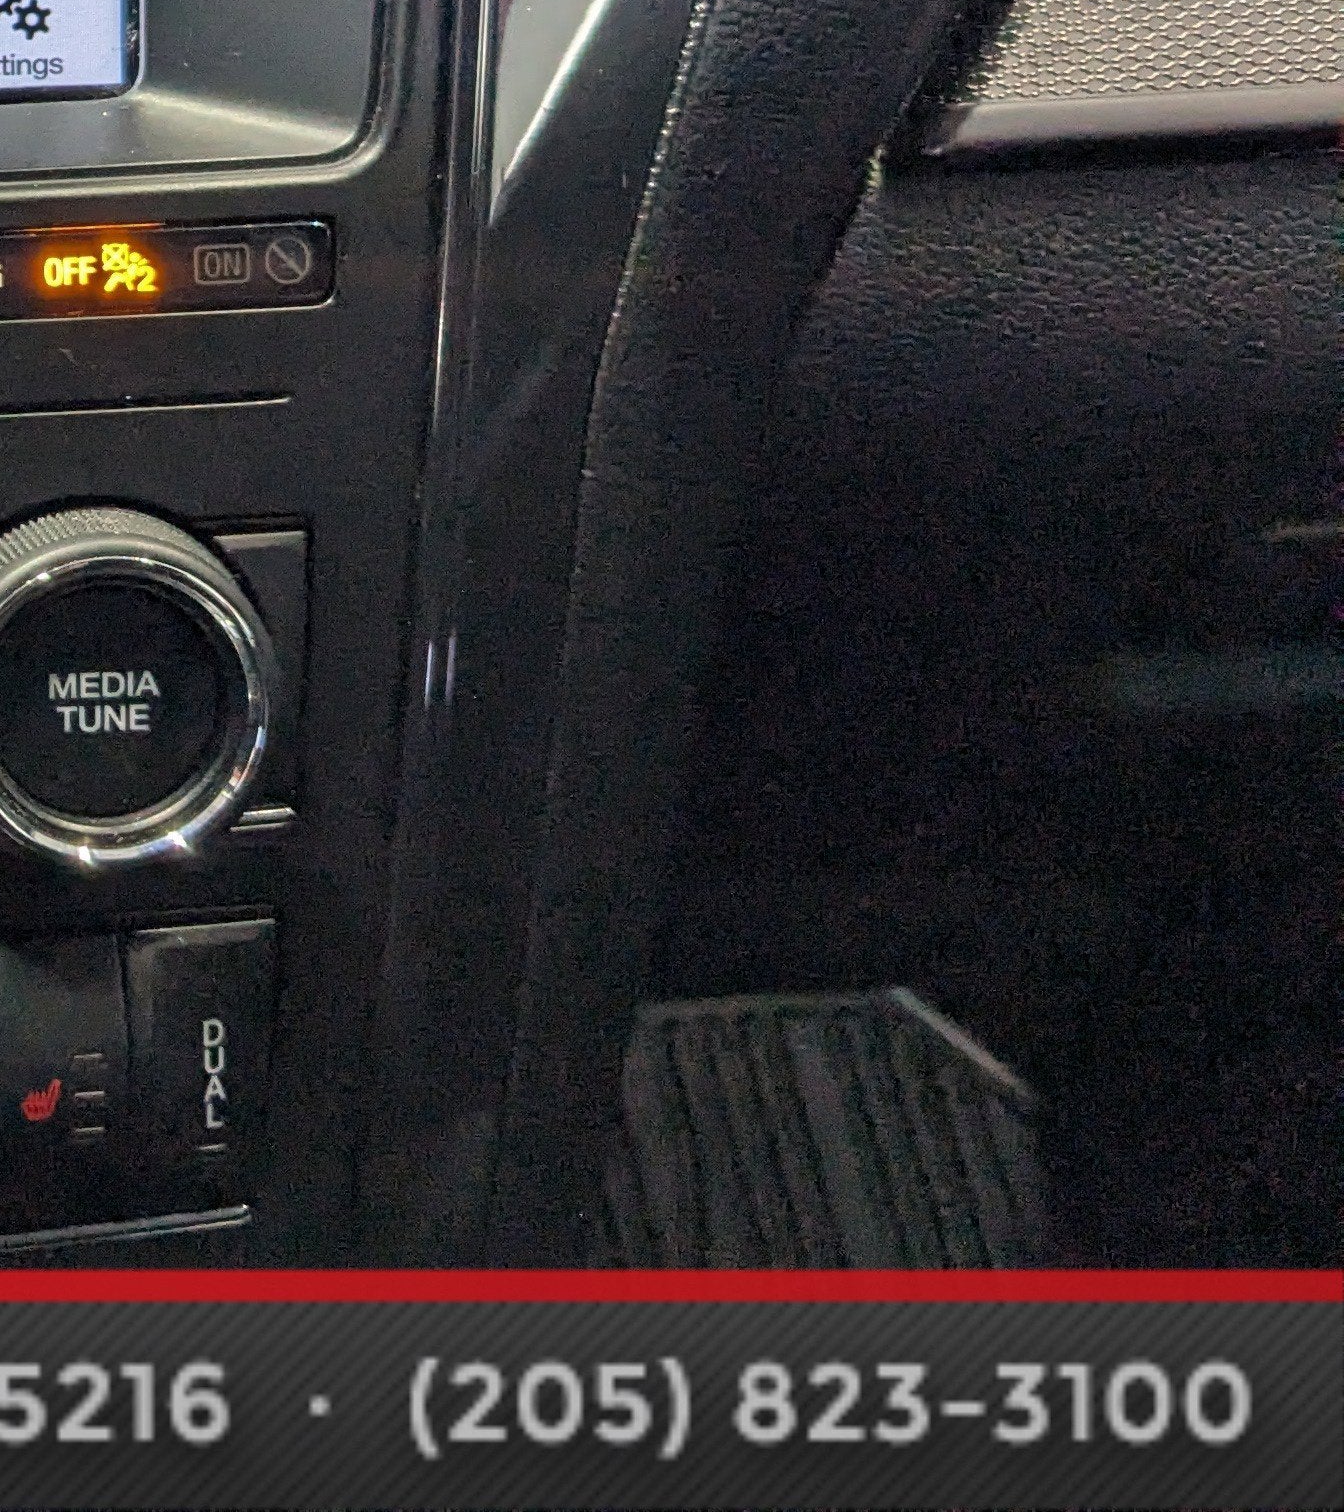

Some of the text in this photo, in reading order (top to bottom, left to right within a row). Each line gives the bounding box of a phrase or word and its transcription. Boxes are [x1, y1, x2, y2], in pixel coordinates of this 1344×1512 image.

[43, 255, 97, 287] OFF
[202, 251, 241, 279] ON
[48, 670, 161, 700] MEDIA
[56, 703, 152, 734] TUNE
[202, 1018, 226, 1129] DUAL
